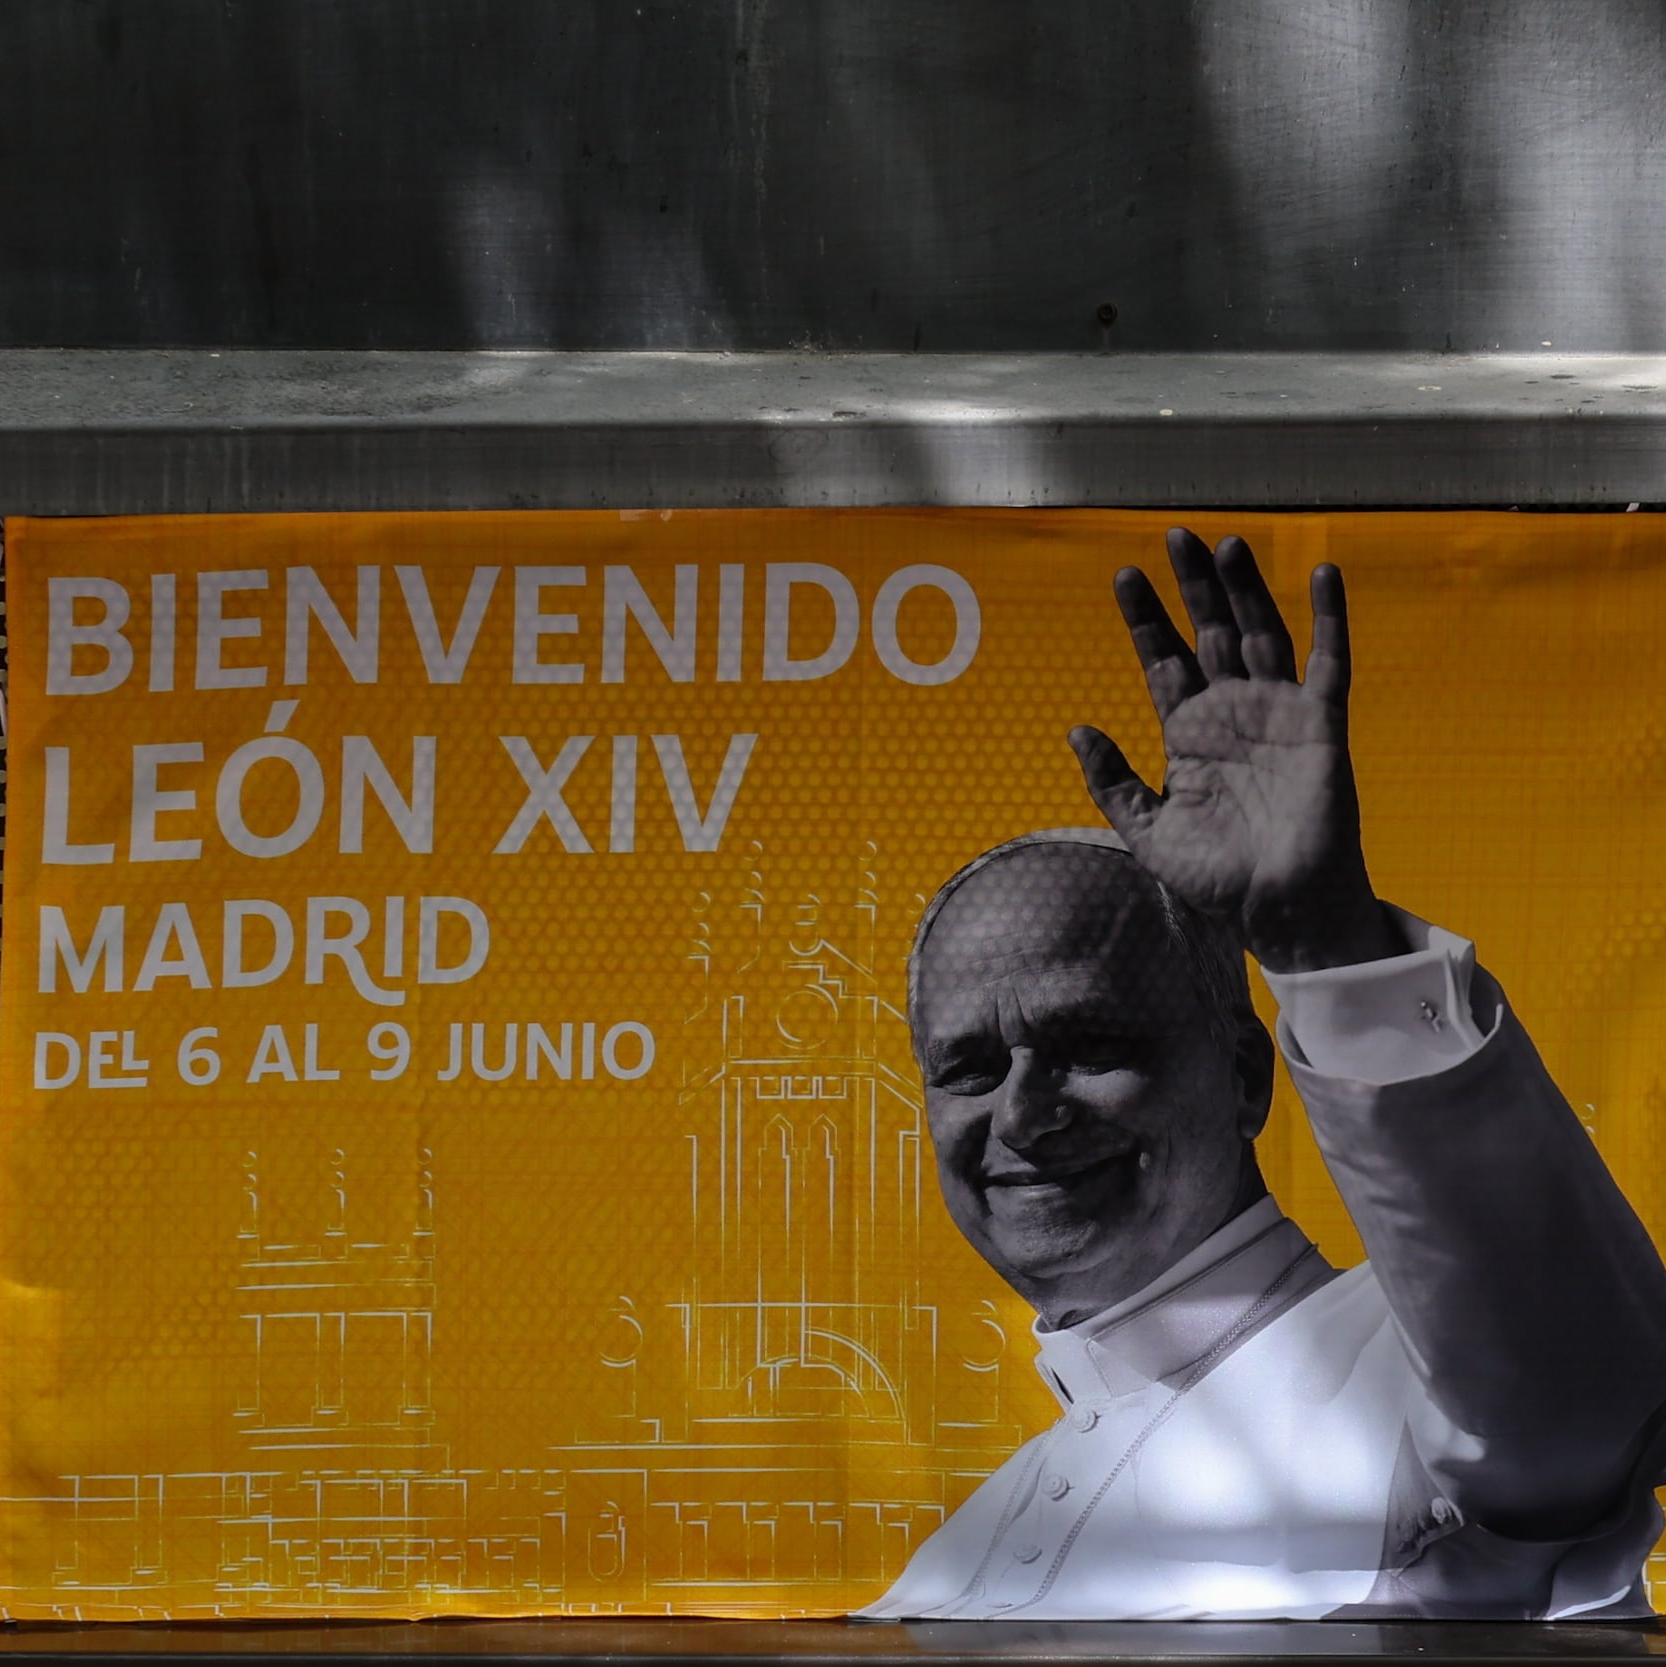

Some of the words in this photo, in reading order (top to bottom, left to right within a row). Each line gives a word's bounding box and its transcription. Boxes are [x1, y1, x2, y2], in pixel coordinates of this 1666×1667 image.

[46, 562, 981, 695] BIENVENIDO
[41, 699, 436, 865] LEÓN
[493, 733, 758, 855] XIV
[38, 895, 491, 1006] MADRID
[34, 1030, 149, 1090] DEL
[177, 1026, 221, 1086] 6
[247, 1023, 340, 1083] AL
[366, 1021, 411, 1081] 9
[437, 1020, 656, 1081] JUNIO
